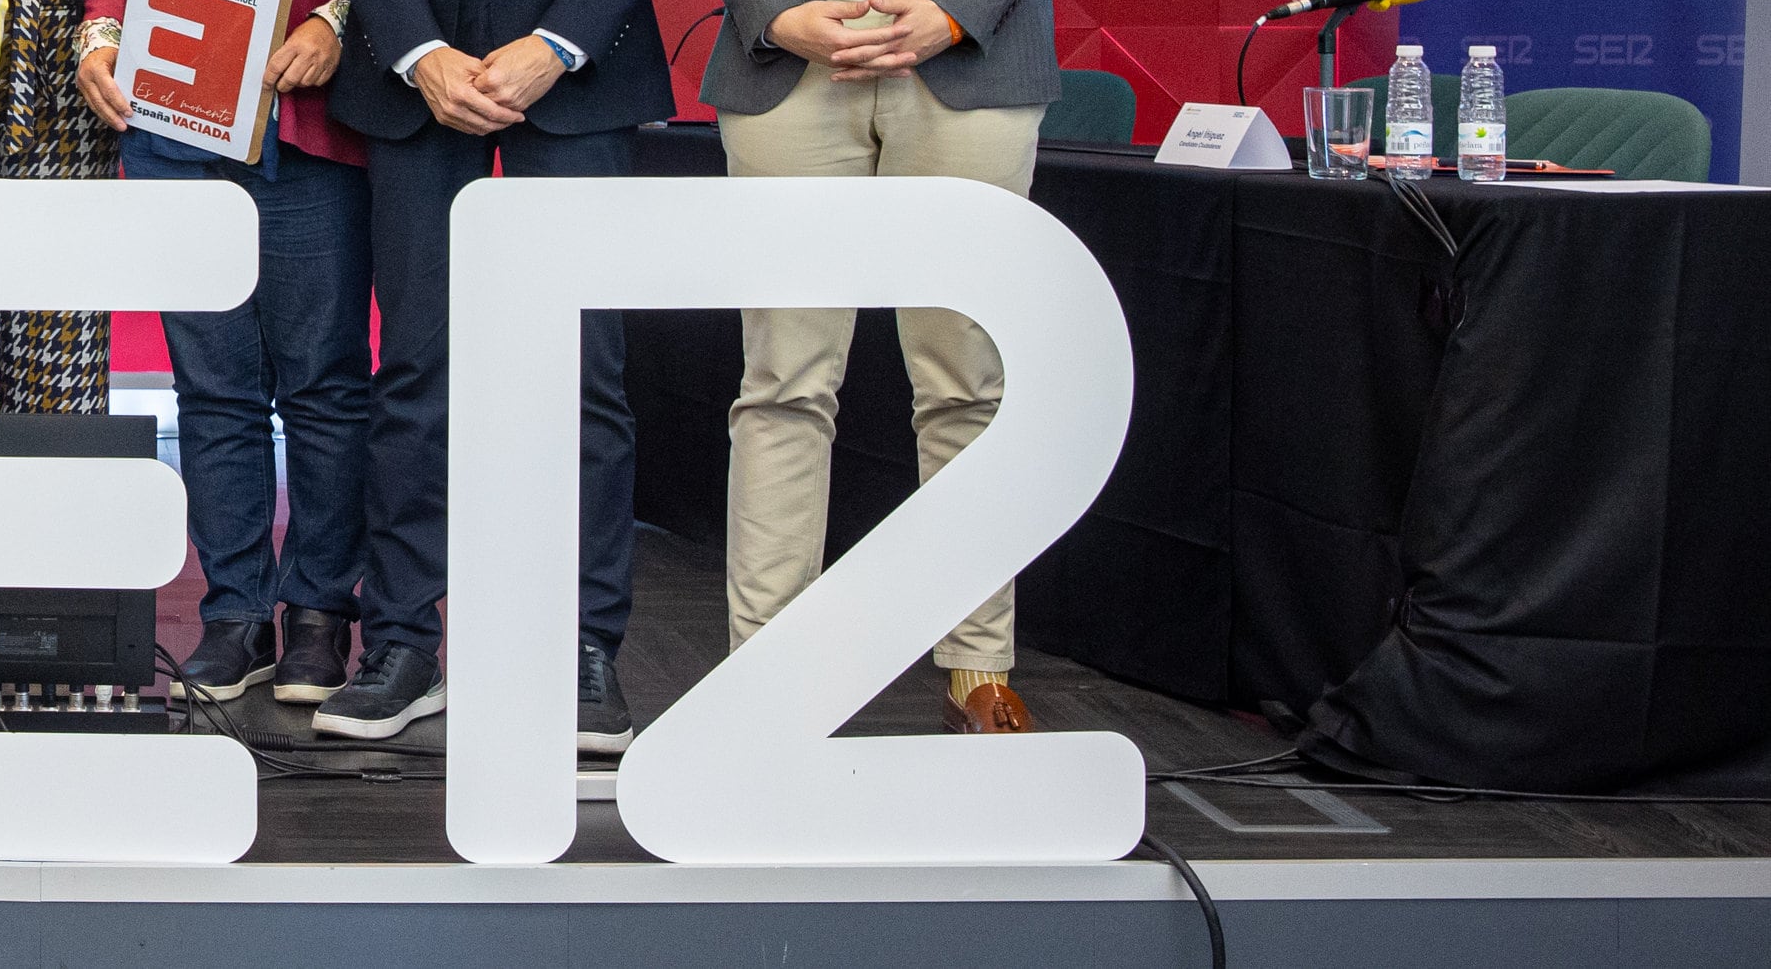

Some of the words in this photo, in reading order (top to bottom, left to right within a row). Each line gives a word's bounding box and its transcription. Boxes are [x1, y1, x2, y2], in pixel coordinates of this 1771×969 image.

[129, 100, 171, 123] España
[172, 114, 231, 142] VACIADA
[135, 81, 153, 99] Es
[160, 90, 175, 105] el
[180, 100, 232, 122] momento
